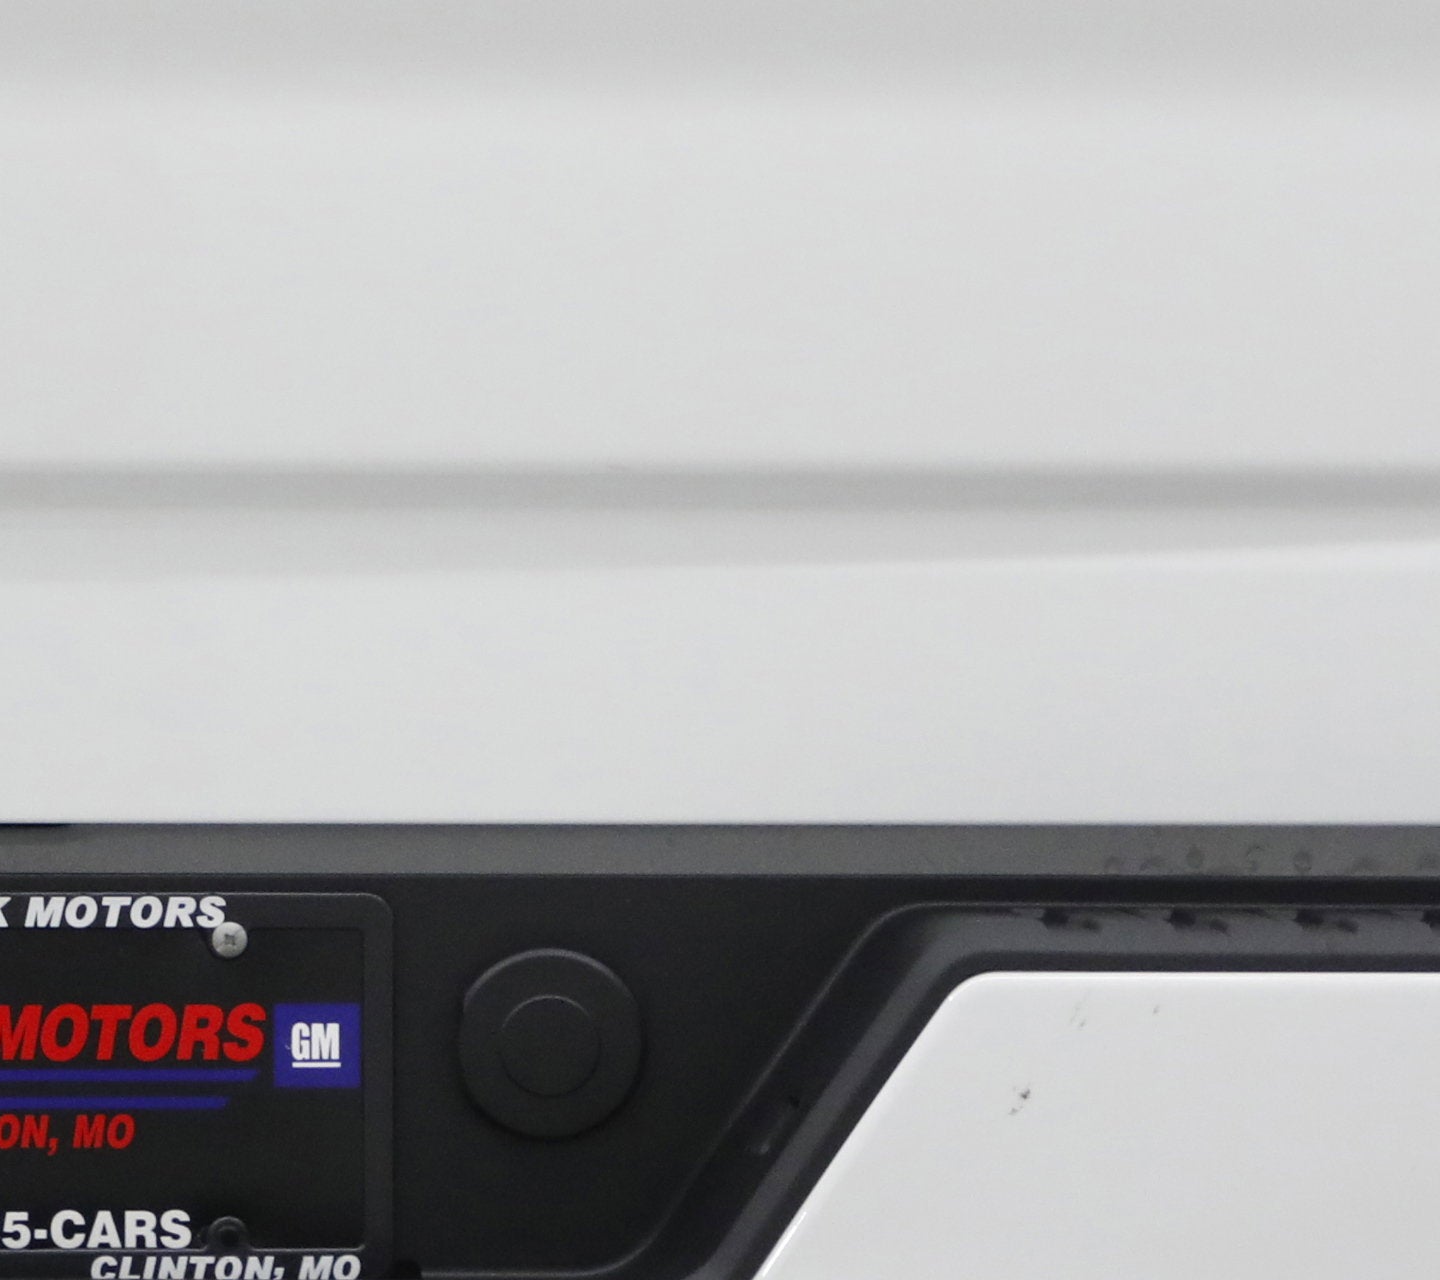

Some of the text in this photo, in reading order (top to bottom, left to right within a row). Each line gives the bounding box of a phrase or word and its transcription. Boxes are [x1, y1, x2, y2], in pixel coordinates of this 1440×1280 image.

[23, 895, 227, 929] MOTORS
[290, 1021, 341, 1062] GM
[71, 1113, 136, 1150] MO
[90, 1254, 362, 1280] CLINTON, MO
